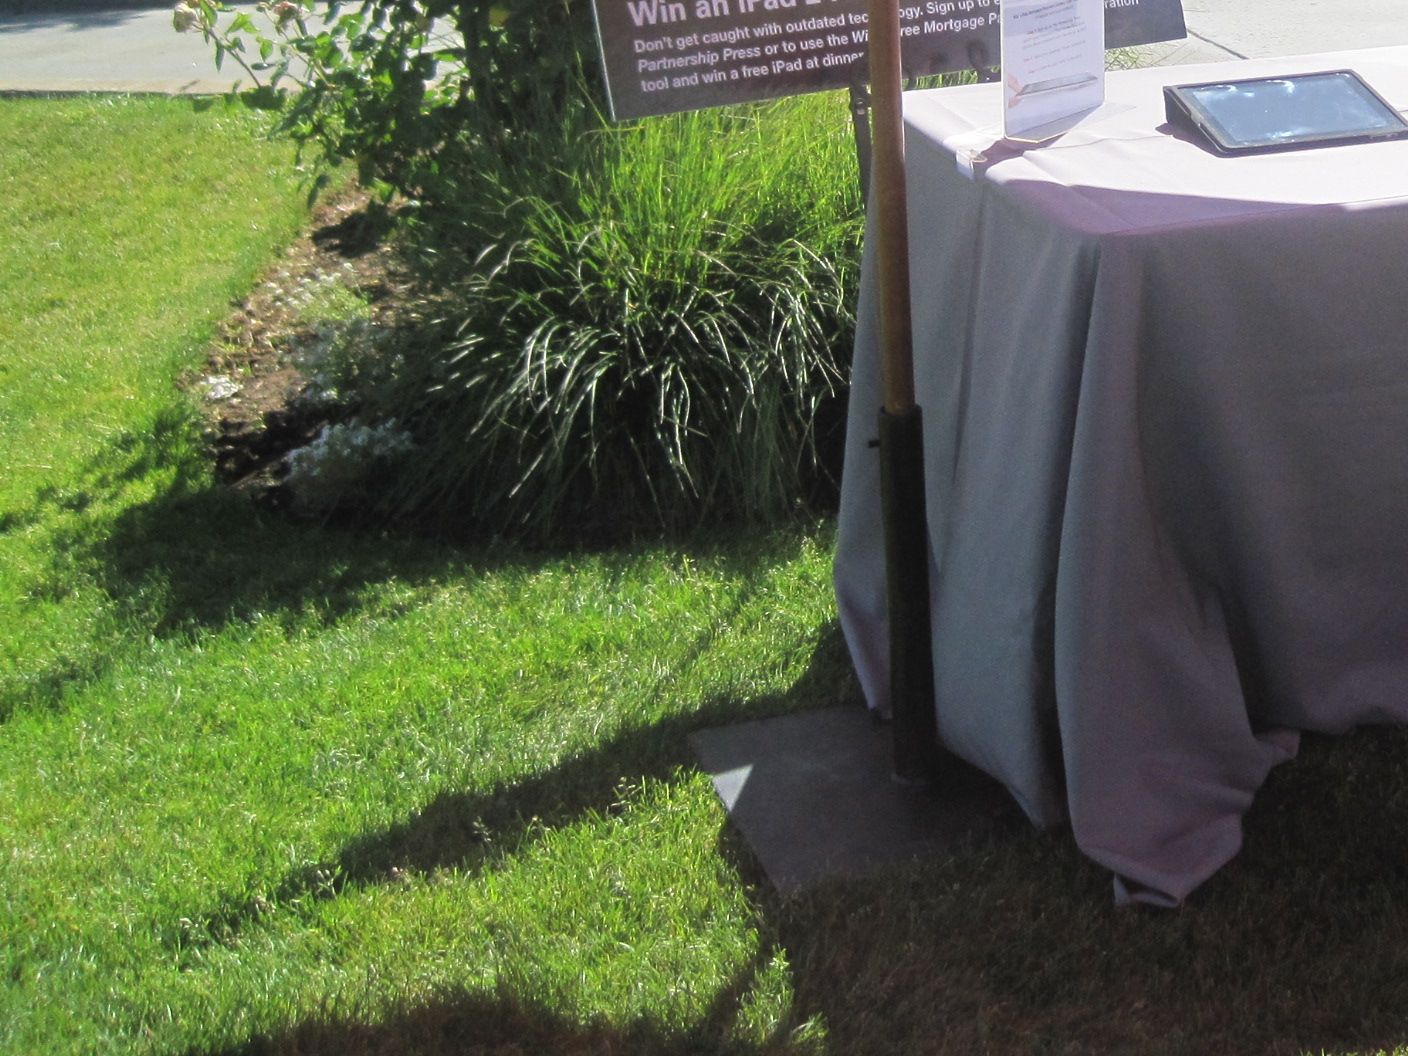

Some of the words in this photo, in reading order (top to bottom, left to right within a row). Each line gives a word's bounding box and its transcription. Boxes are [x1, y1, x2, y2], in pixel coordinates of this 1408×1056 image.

[634, 36, 674, 54] Don't
[676, 32, 700, 51] get
[702, 26, 751, 44] caught
[753, 22, 783, 38] with
[786, 13, 846, 33] outdated
[926, 1, 955, 16] Sign
[638, 50, 719, 73] Partnership
[723, 46, 761, 62] Press
[764, 44, 779, 56] or
[781, 40, 797, 53] to
[800, 38, 824, 51] use
[827, 33, 849, 48] the
[924, 16, 985, 34] Mortgage
[640, 76, 669, 93] tool
[672, 72, 699, 88] and
[702, 69, 727, 84] win
[730, 69, 739, 80] a
[742, 64, 769, 78] free
[772, 58, 803, 74] iPad
[806, 56, 820, 69] at
